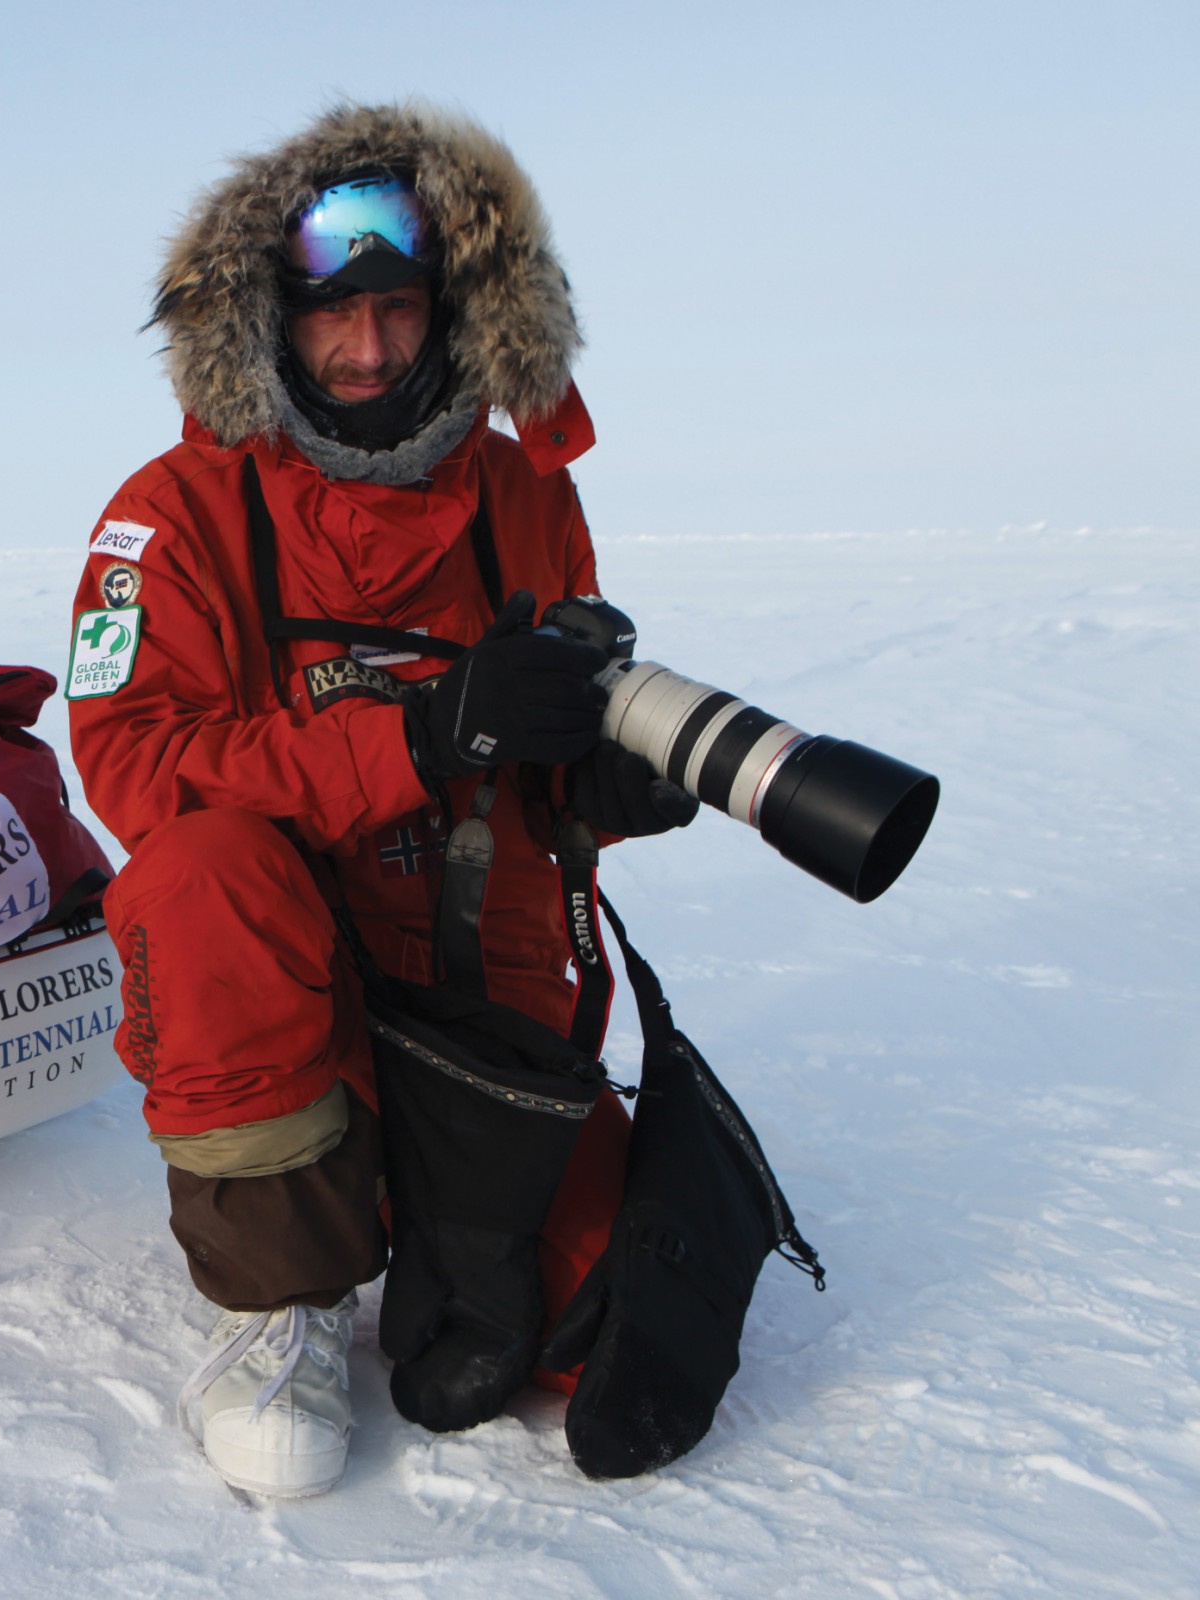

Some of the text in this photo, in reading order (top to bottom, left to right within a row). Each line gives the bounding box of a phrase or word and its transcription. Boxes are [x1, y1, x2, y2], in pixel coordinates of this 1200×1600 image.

[96, 528, 141, 551] Lexar
[76, 659, 121, 674] GLOBAL
[74, 670, 120, 684] GREEN
[571, 892, 598, 965] Canon
